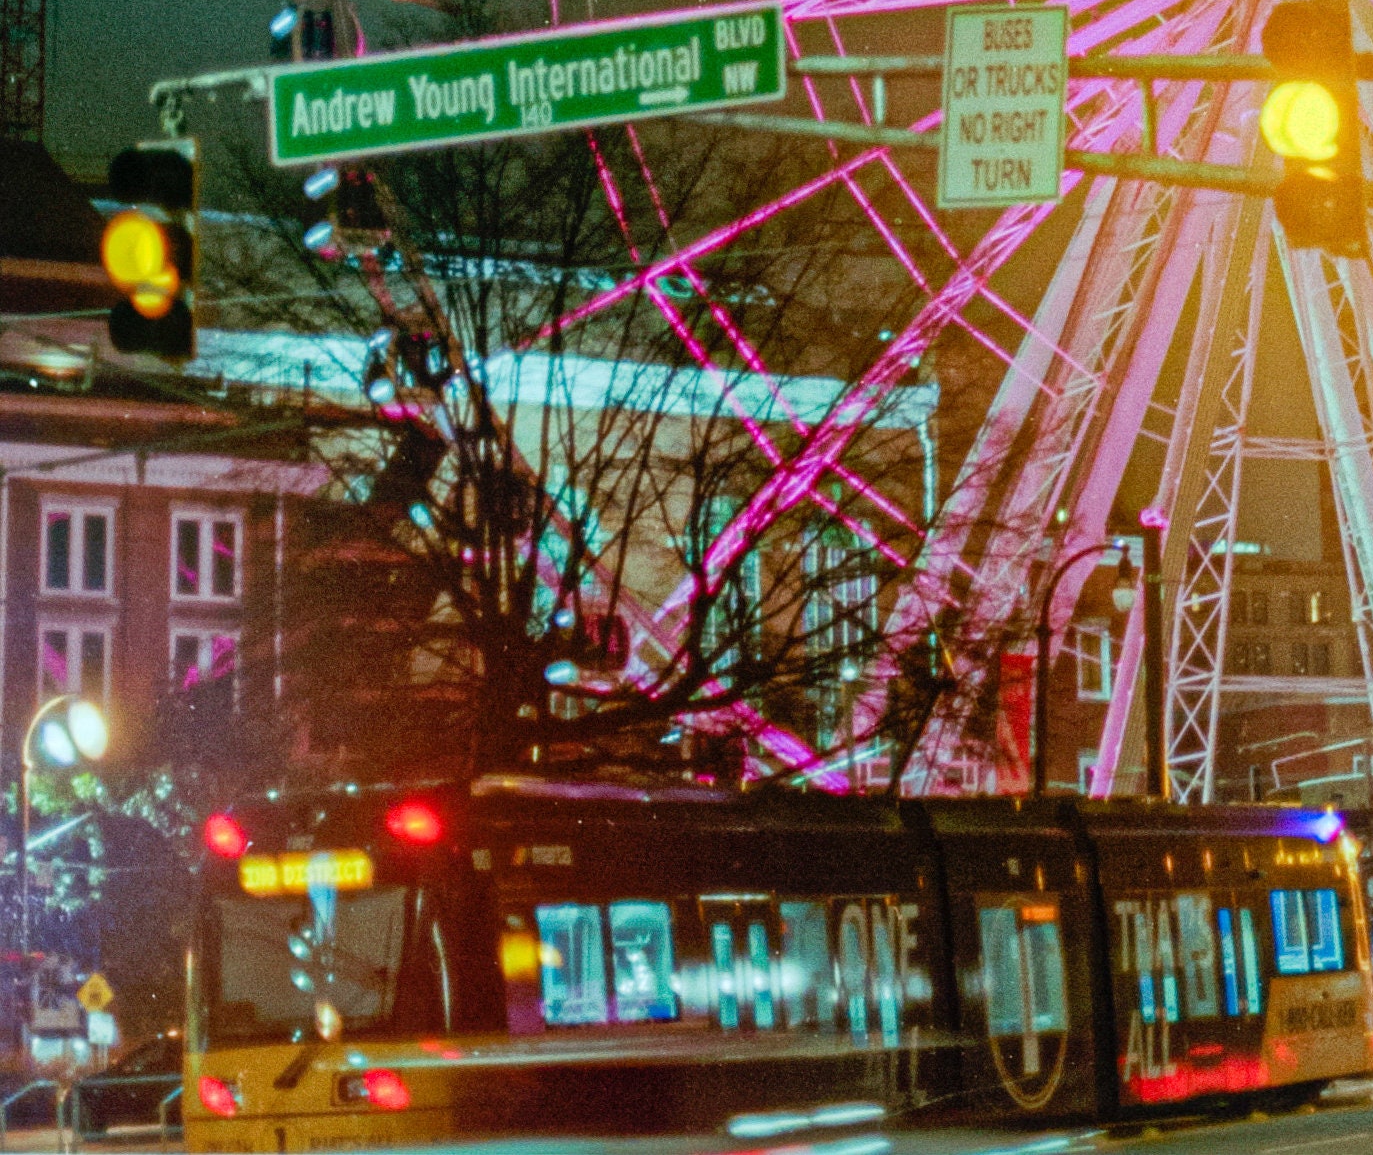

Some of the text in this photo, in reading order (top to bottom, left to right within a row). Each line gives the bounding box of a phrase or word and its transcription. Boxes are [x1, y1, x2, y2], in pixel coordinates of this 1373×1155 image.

[714, 14, 766, 52] BLVD
[982, 18, 1034, 52] BUSES
[290, 38, 701, 138] Andrew Young International
[722, 61, 758, 97] NW
[953, 62, 1059, 99] OR TRUCKS
[520, 100, 553, 128] 140
[959, 109, 1048, 145] NO RIGHT
[971, 157, 1033, 192] TURN
